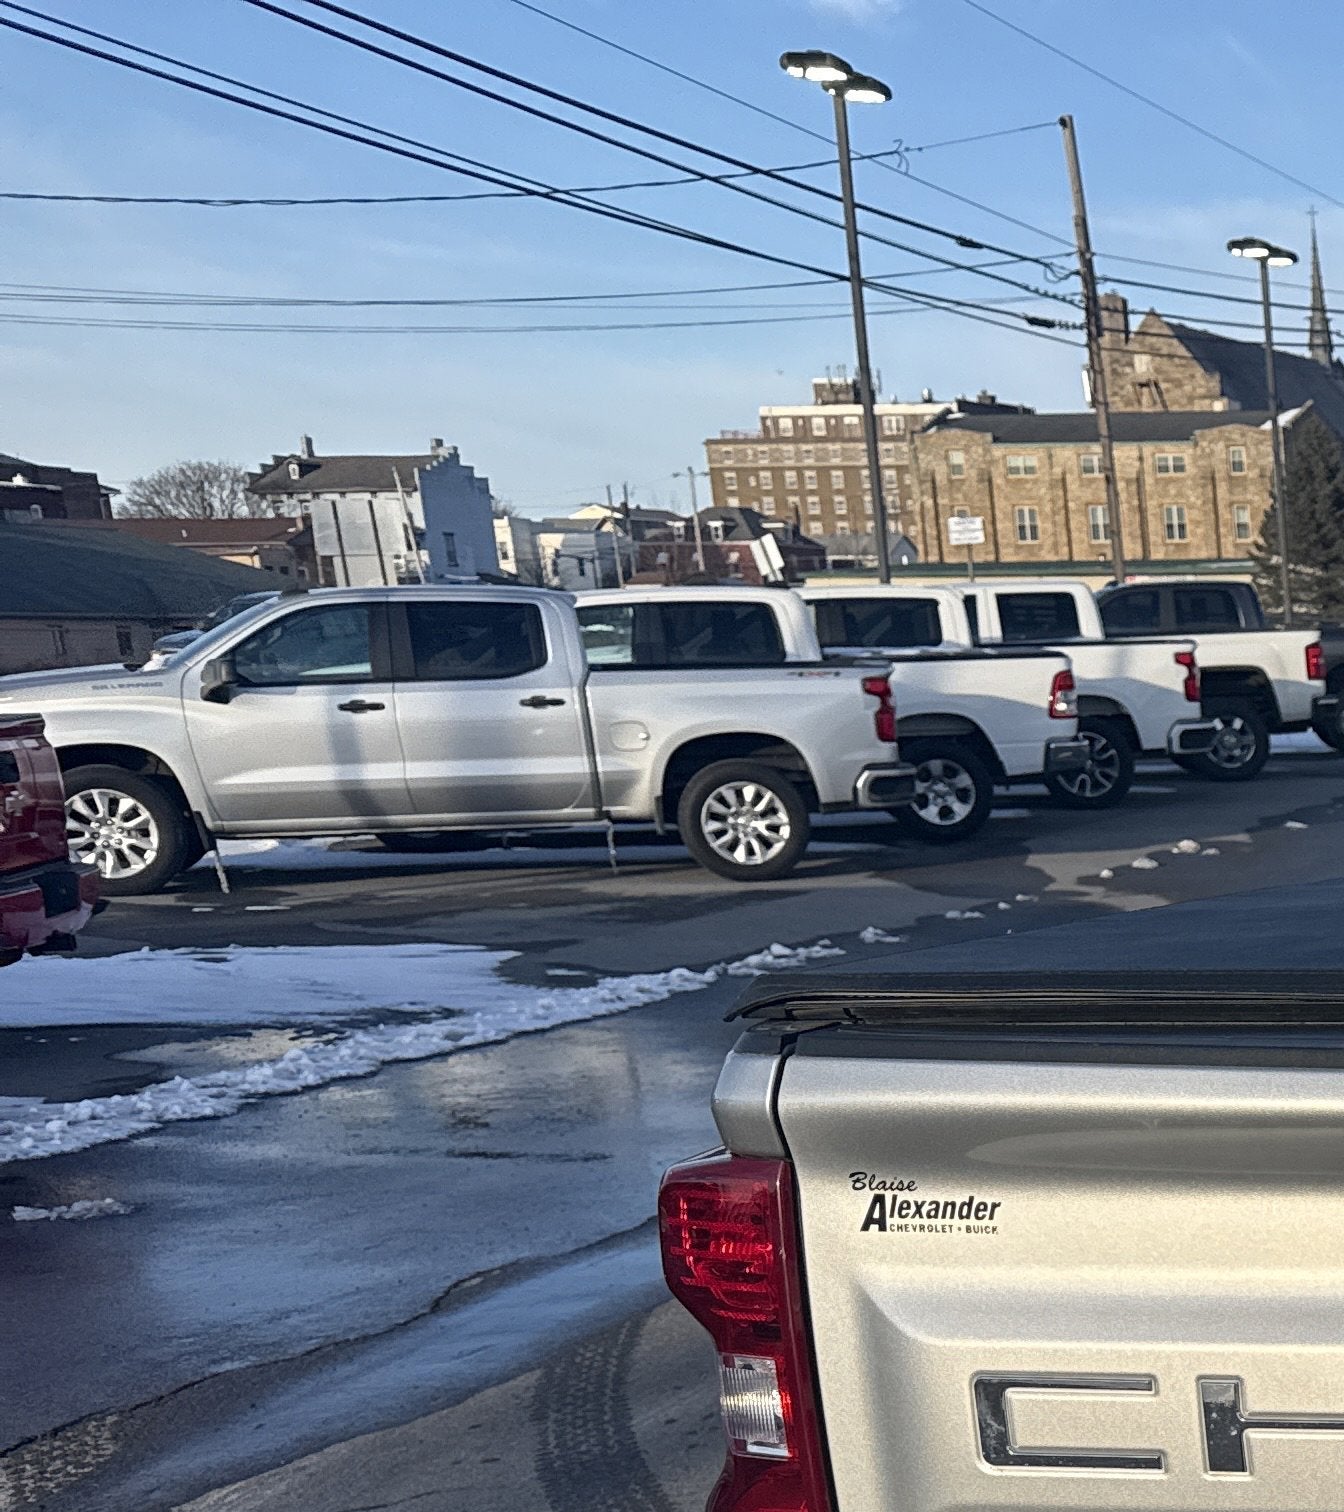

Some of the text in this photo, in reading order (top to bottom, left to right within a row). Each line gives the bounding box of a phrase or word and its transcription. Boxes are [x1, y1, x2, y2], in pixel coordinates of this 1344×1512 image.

[848, 1171, 918, 1192] Blaise
[860, 1193, 1001, 1232] Alexander
[889, 1223, 954, 1233] CHEVROLET
